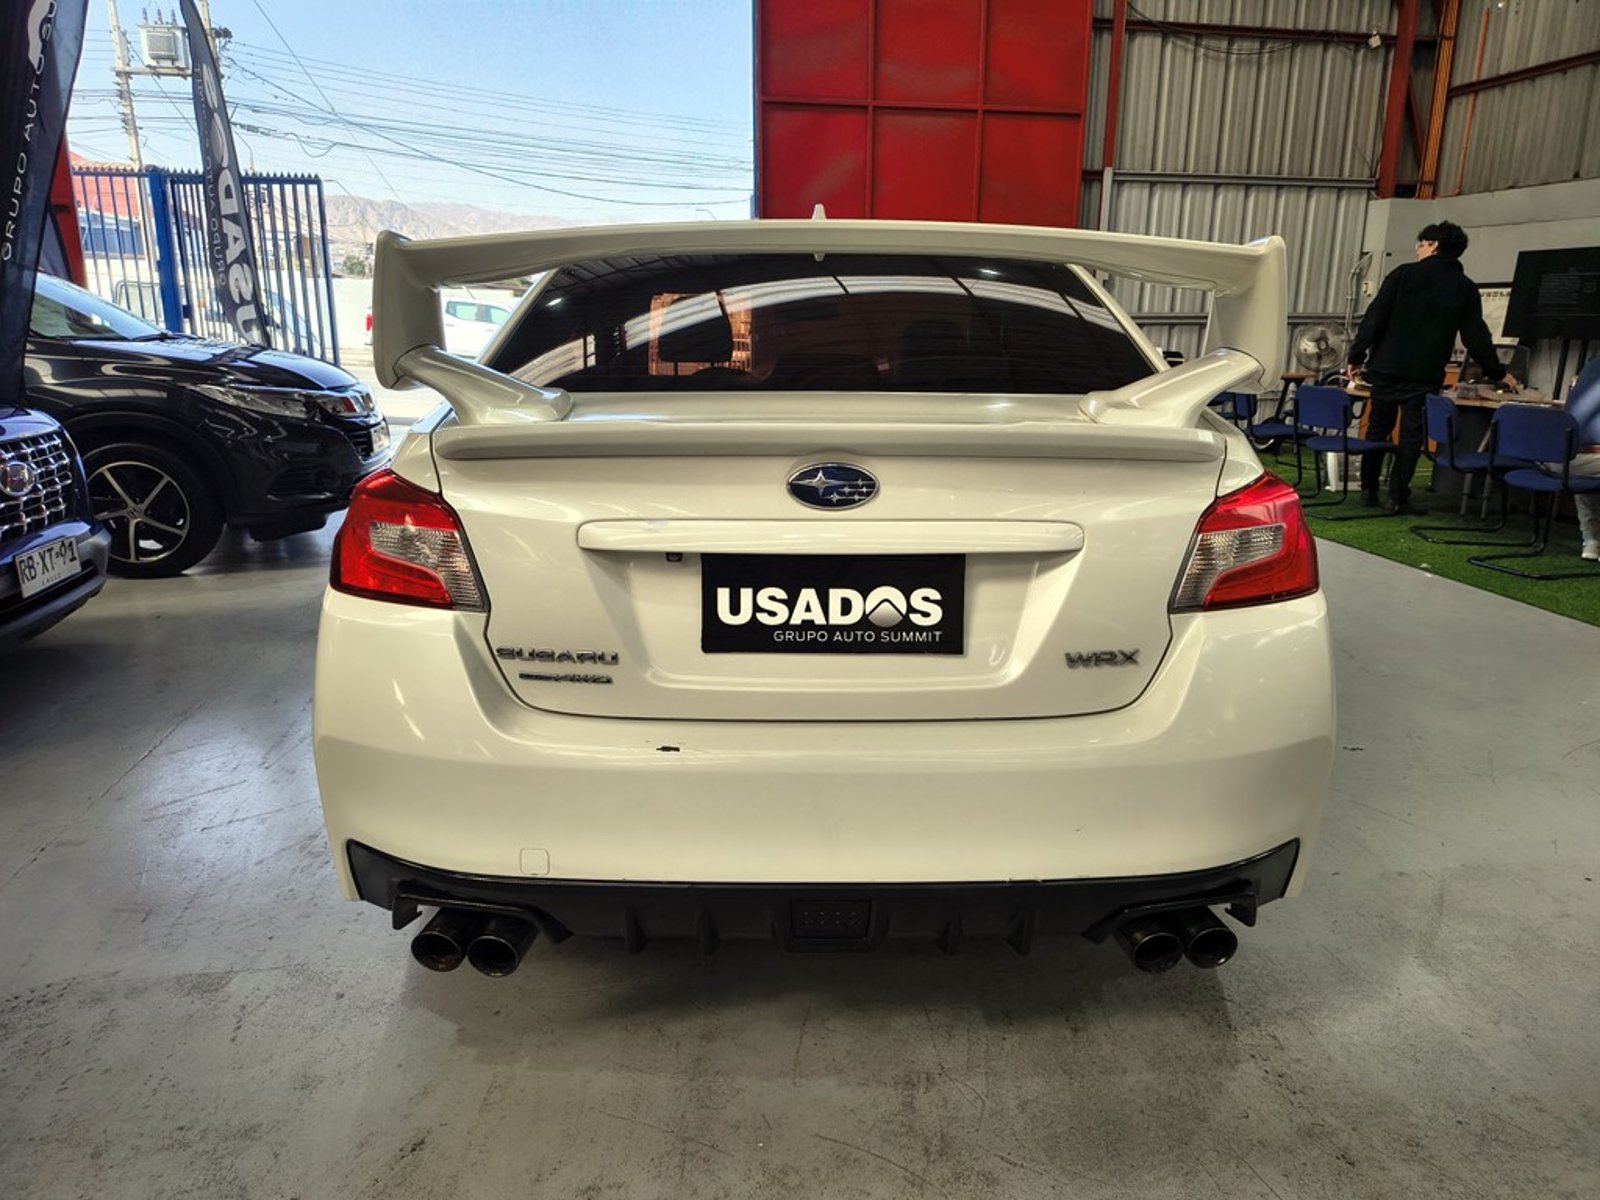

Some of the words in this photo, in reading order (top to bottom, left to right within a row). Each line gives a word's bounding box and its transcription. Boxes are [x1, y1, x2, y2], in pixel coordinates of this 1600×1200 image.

[1, 152, 28, 261] GRUPO
[23, 53, 45, 142] AUTO
[716, 585, 943, 628] USADOS
[773, 630, 829, 643] GRUPO
[833, 630, 876, 643] AUTO
[880, 630, 943, 643] SUMMIT
[495, 647, 619, 666] SUBARU
[1064, 647, 1140, 669] WRX
